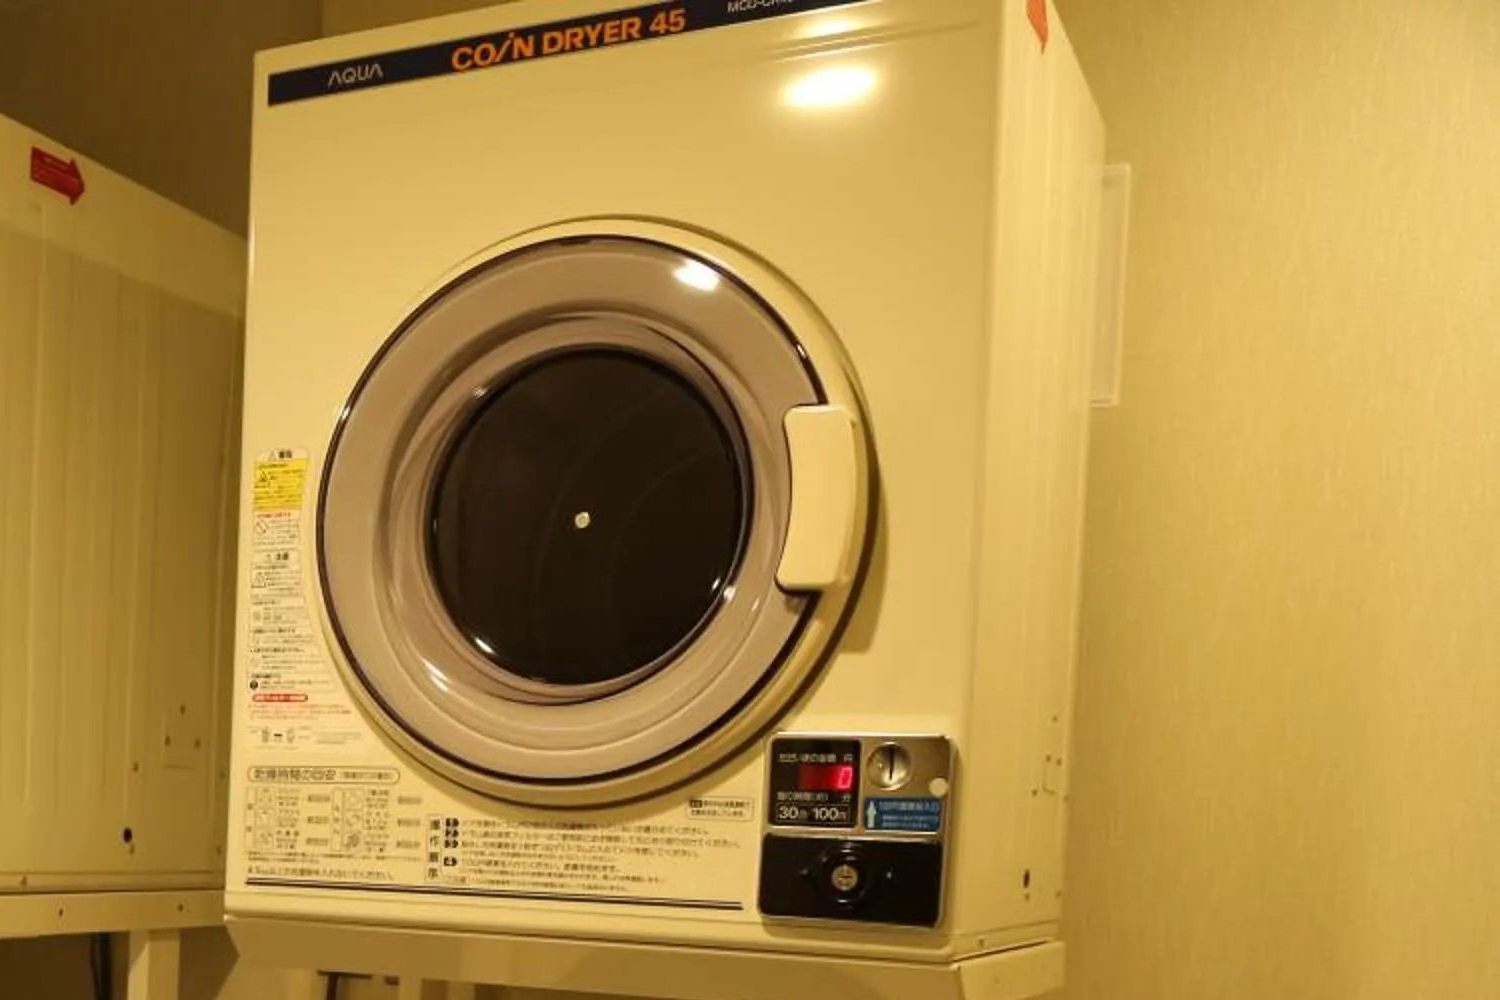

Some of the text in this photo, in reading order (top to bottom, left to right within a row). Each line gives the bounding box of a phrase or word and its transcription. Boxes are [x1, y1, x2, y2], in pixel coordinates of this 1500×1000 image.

[542, 15, 642, 55] DRYER
[649, 8, 686, 33] 45
[327, 63, 384, 87] AQUA
[837, 765, 853, 789] 0
